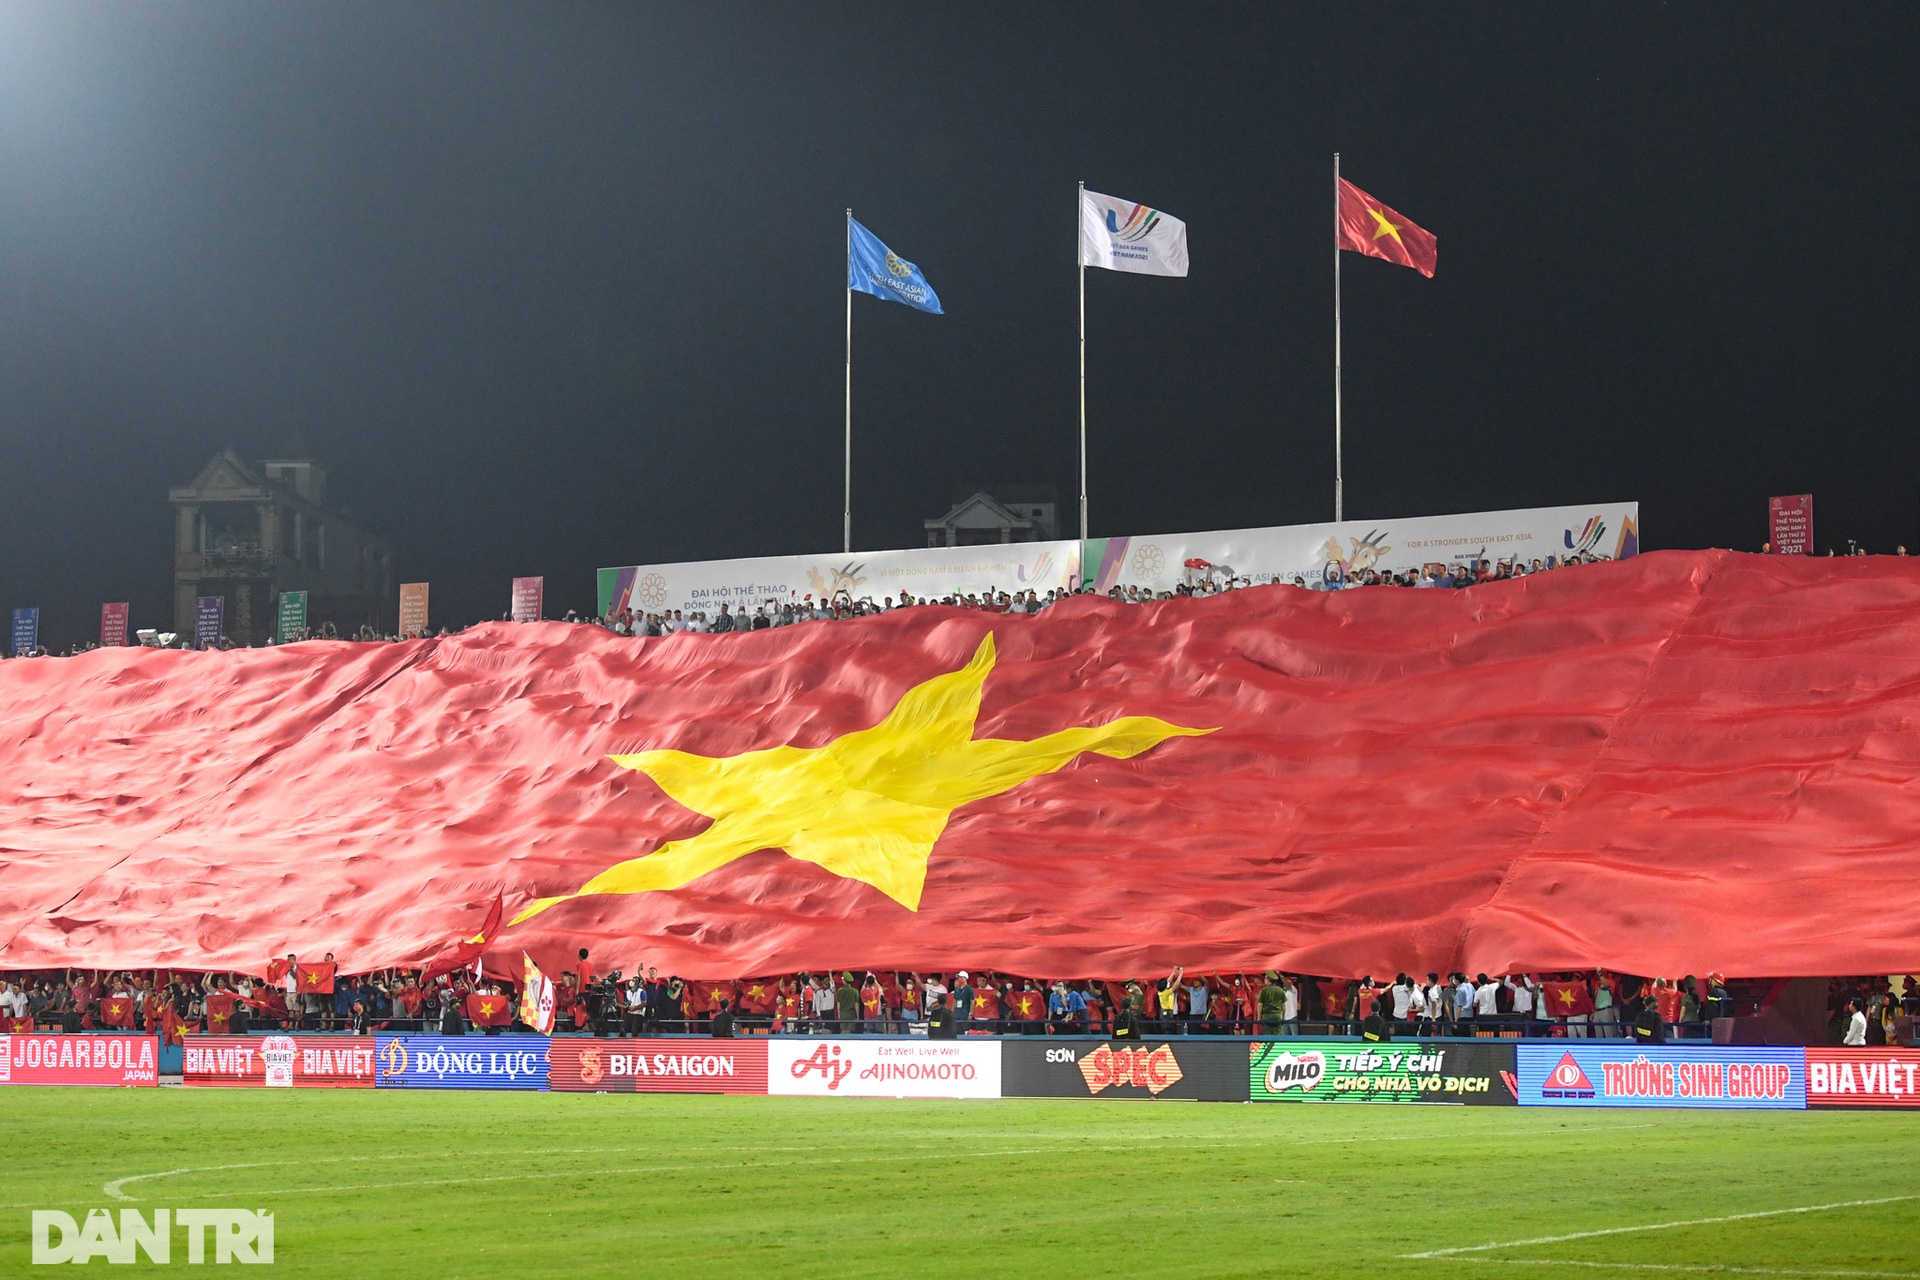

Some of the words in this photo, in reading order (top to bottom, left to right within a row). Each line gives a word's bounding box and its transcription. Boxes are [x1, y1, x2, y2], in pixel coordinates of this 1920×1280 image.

[888, 278, 905, 289] EAST
[905, 284, 926, 295] ASIAN
[1430, 538, 1468, 547] STRONGER
[1781, 545, 1802, 554] 2021
[1255, 572, 1284, 582] ASIAN
[1287, 570, 1322, 580] GAMES
[691, 590, 710, 600] ĐẠI
[712, 586, 731, 598] HỘI
[757, 584, 787, 594] THAO
[14, 1040, 154, 1068] JOGARBOLA
[878, 1047, 892, 1056] Eat
[919, 1047, 937, 1056] Live
[940, 1047, 959, 1056] Well
[1335, 1049, 1384, 1071] TIẾP
[1388, 1051, 1403, 1071] Ý
[1407, 1051, 1445, 1071] CHÍ
[416, 1046, 483, 1079] ĐỘNG
[489, 1050, 536, 1080] LỰC
[610, 1055, 650, 1075] BIA
[654, 1054, 734, 1076] SAIGON
[1046, 1048, 1075, 1062] SƠN
[1094, 1050, 1167, 1086] SPEC
[1274, 1063, 1320, 1083] MILO
[122, 1071, 154, 1080] JAPAN
[1333, 1076, 1370, 1091] CHO
[1374, 1073, 1412, 1091] NHÀ
[1444, 1077, 1490, 1095] ĐỊCH
[1602, 1055, 1674, 1097] TRƯỜNG
[1678, 1063, 1723, 1097] SINH
[1728, 1064, 1790, 1099] GROUP
